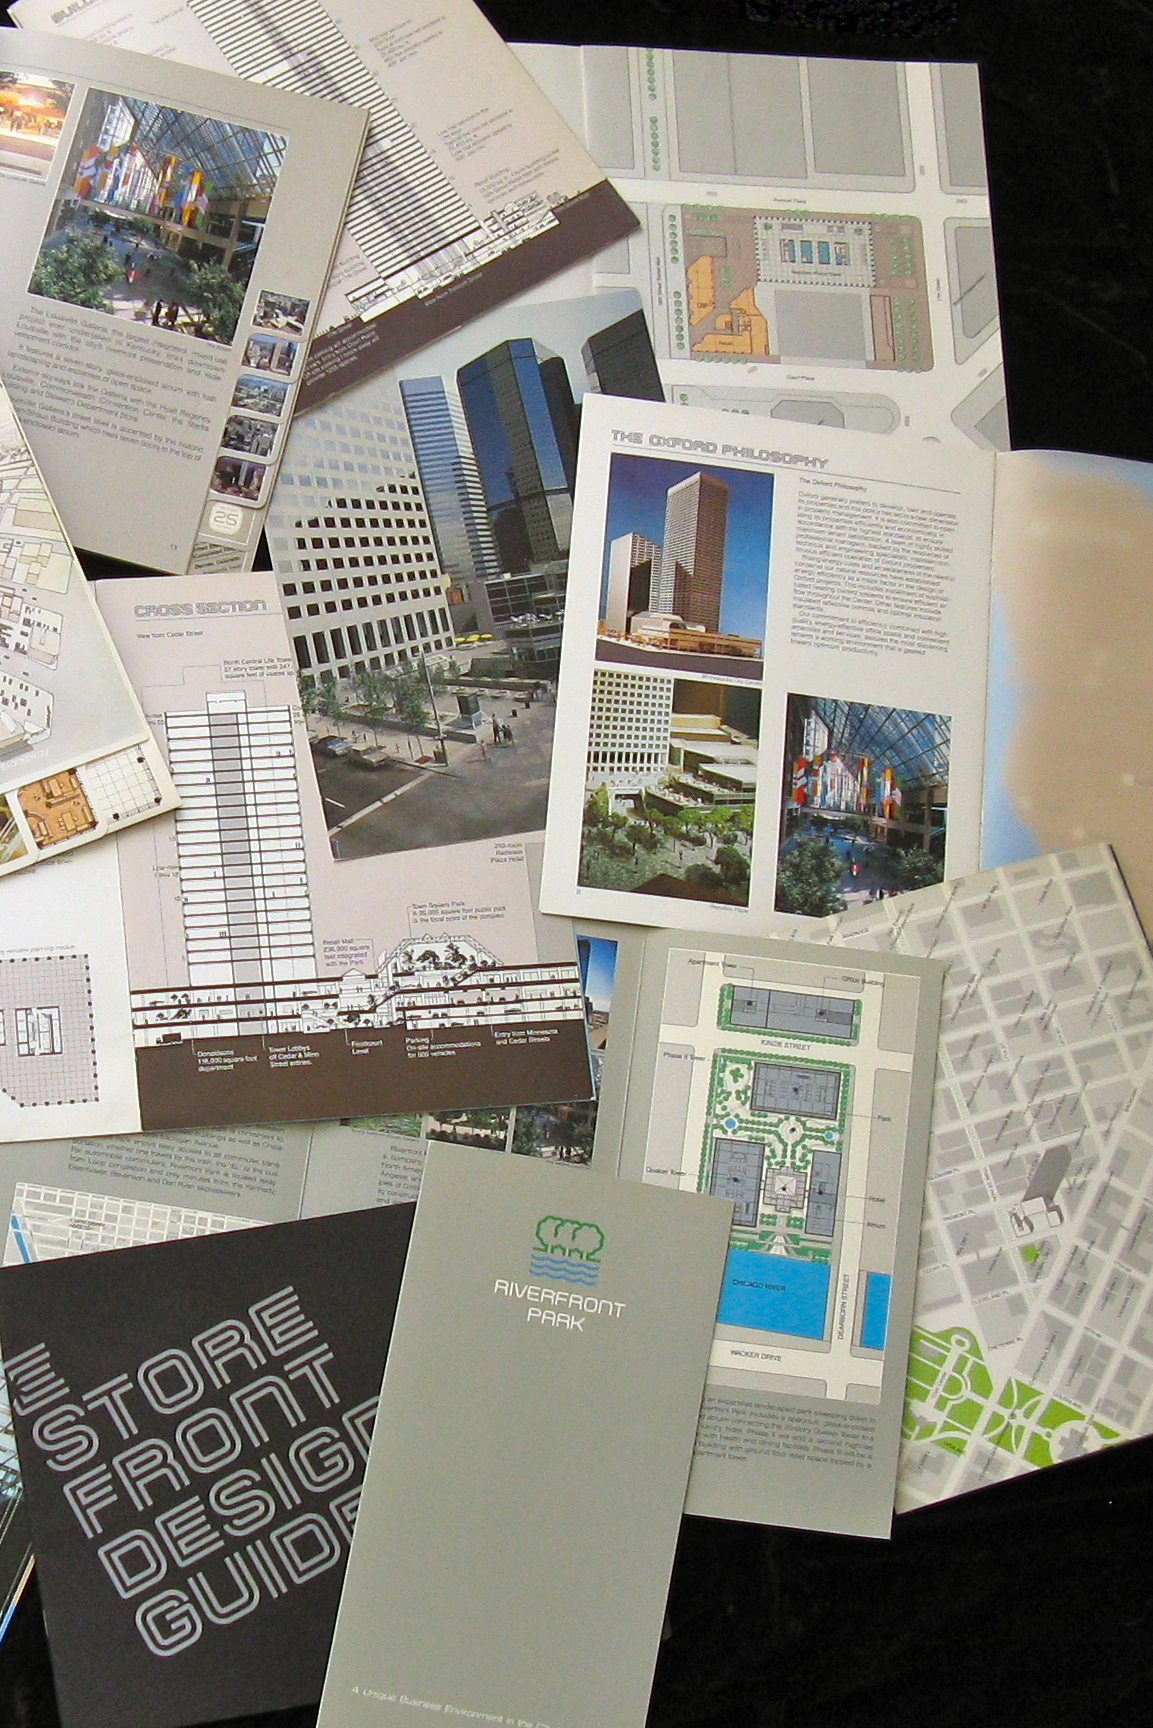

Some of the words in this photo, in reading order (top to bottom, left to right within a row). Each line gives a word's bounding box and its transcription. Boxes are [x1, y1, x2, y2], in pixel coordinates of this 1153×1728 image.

[611, 430, 643, 445] THE
[649, 435, 717, 453] OXFORD
[722, 444, 829, 469] PHILOSOPHY
[214, 510, 239, 526] 25
[134, 602, 193, 619] CROSS
[194, 597, 267, 615] SECTION
[405, 1035, 430, 1045] Parking
[732, 1279, 763, 1290] CHICAGO
[765, 1283, 786, 1292] RIVER
[494, 1279, 627, 1318] RIVERFRONT
[527, 1307, 586, 1332] PARK
[730, 1349, 759, 1359] WACKER
[761, 1353, 782, 1362] DRIVE
[32, 1285, 319, 1472] STORE
[63, 1343, 341, 1539] FRONT
[351, 1686, 360, 1694] A
[363, 1689, 396, 1702] Unique
[399, 1695, 442, 1711] Business
[444, 1704, 504, 1723] Environment
[506, 1717, 515, 1725] in
